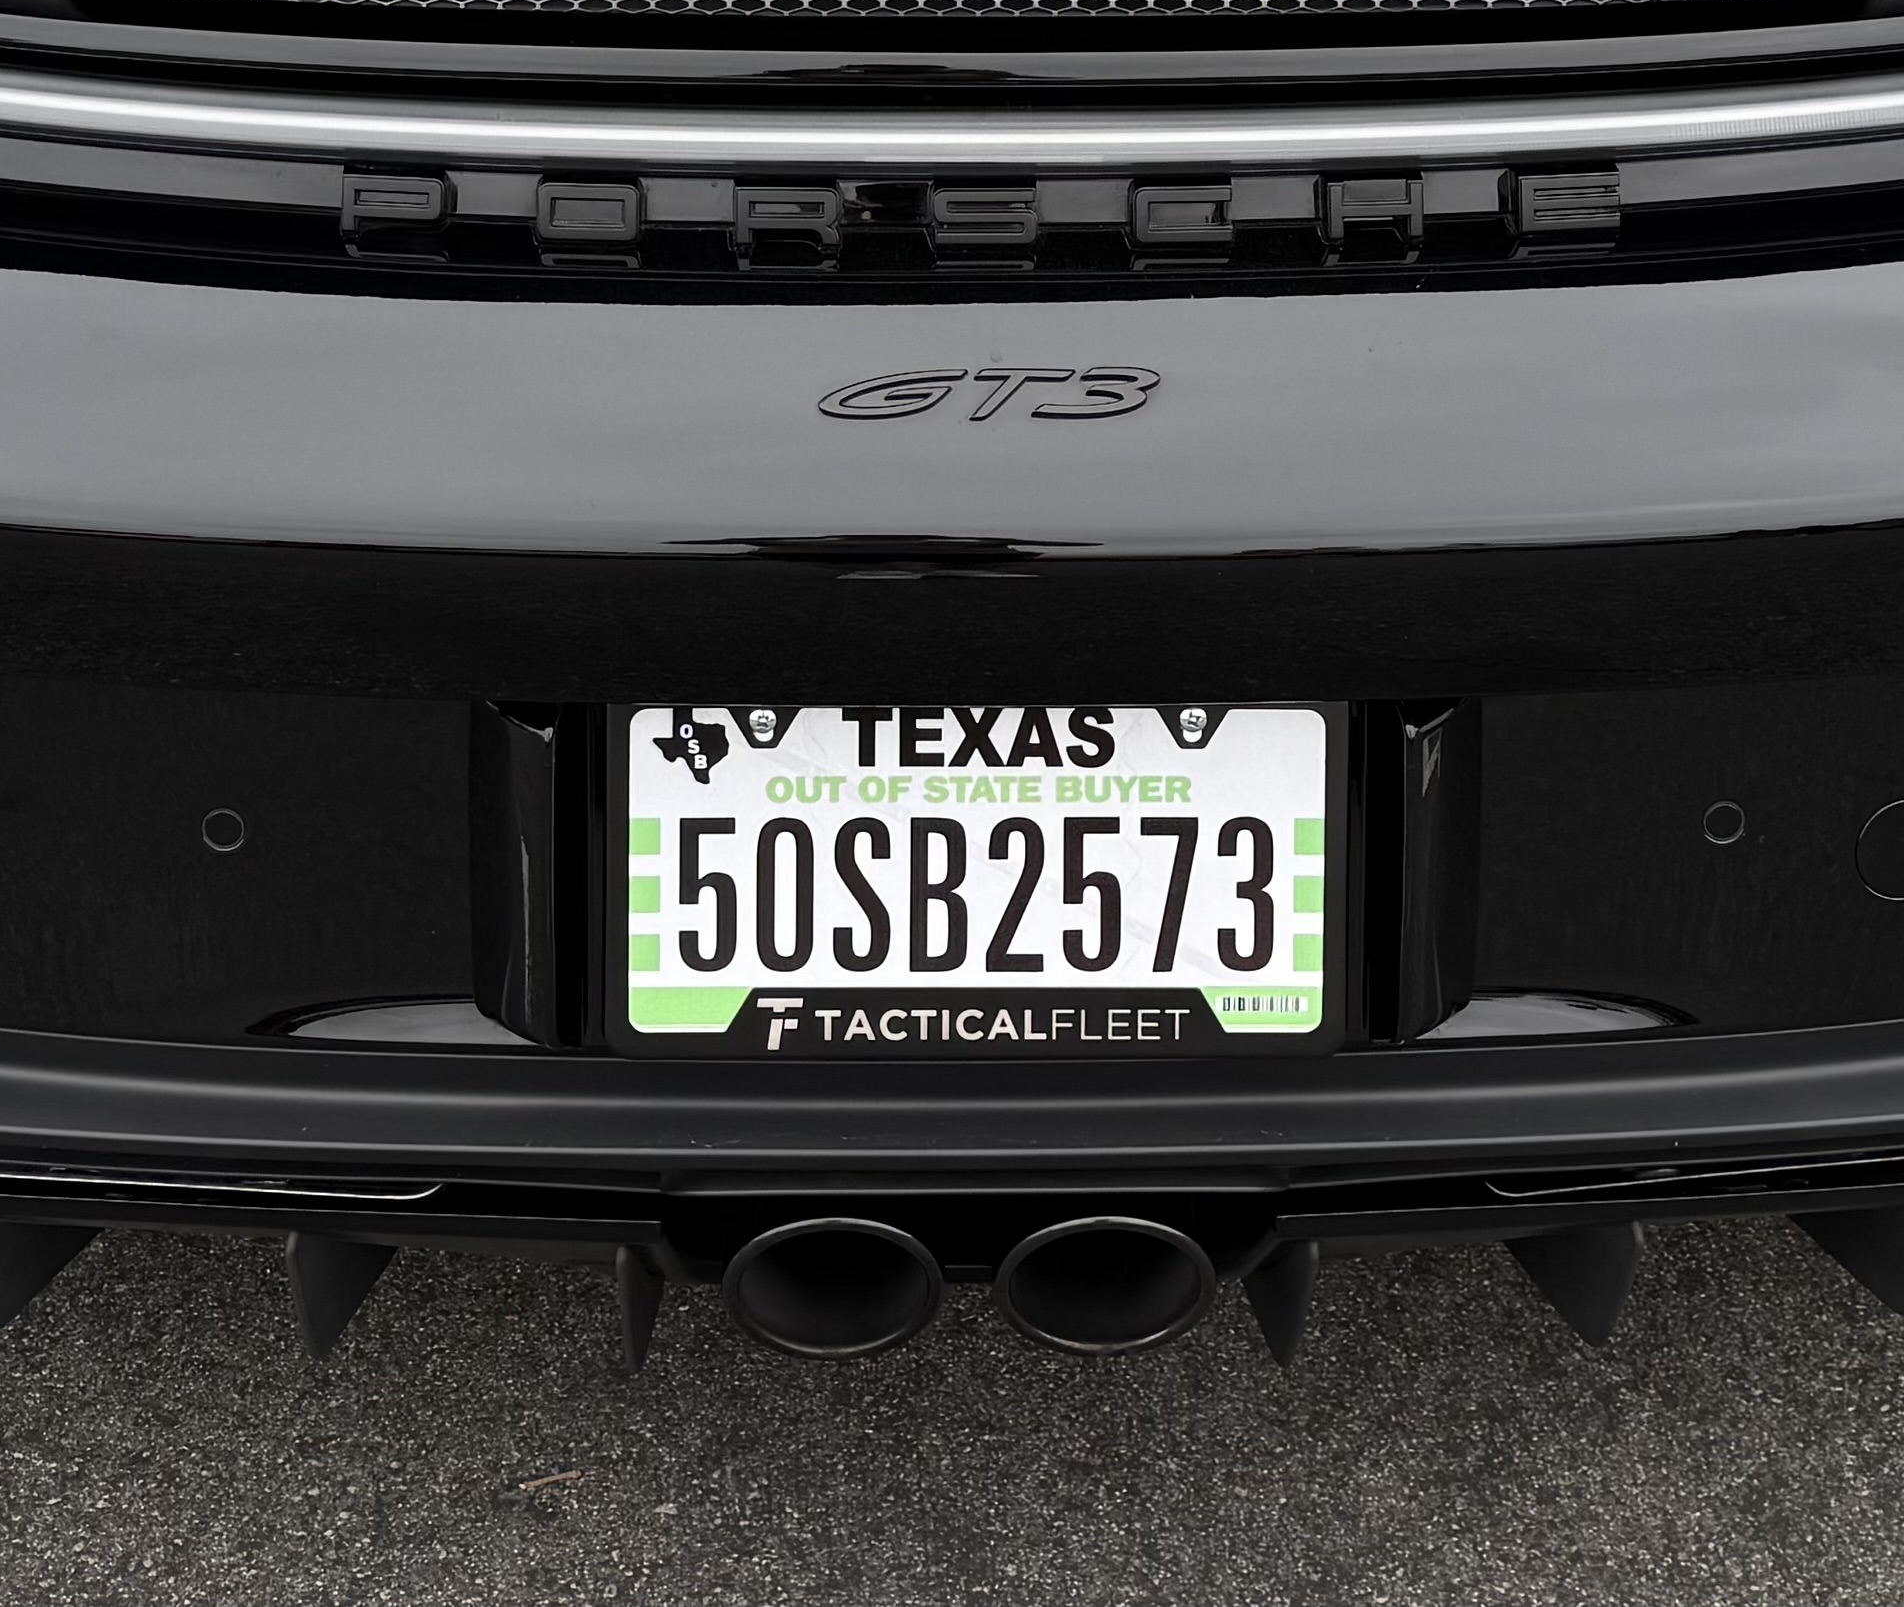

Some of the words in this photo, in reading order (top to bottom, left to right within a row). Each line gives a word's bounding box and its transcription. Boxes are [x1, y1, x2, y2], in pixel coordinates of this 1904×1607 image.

[340, 170, 1622, 246] PORSCHE
[816, 365, 1163, 422] GT3
[841, 706, 1116, 768] TEXAS
[765, 775, 848, 804] OUT
[857, 775, 913, 804] OF
[923, 775, 1042, 804] STATE
[1055, 775, 1193, 804] BUYER
